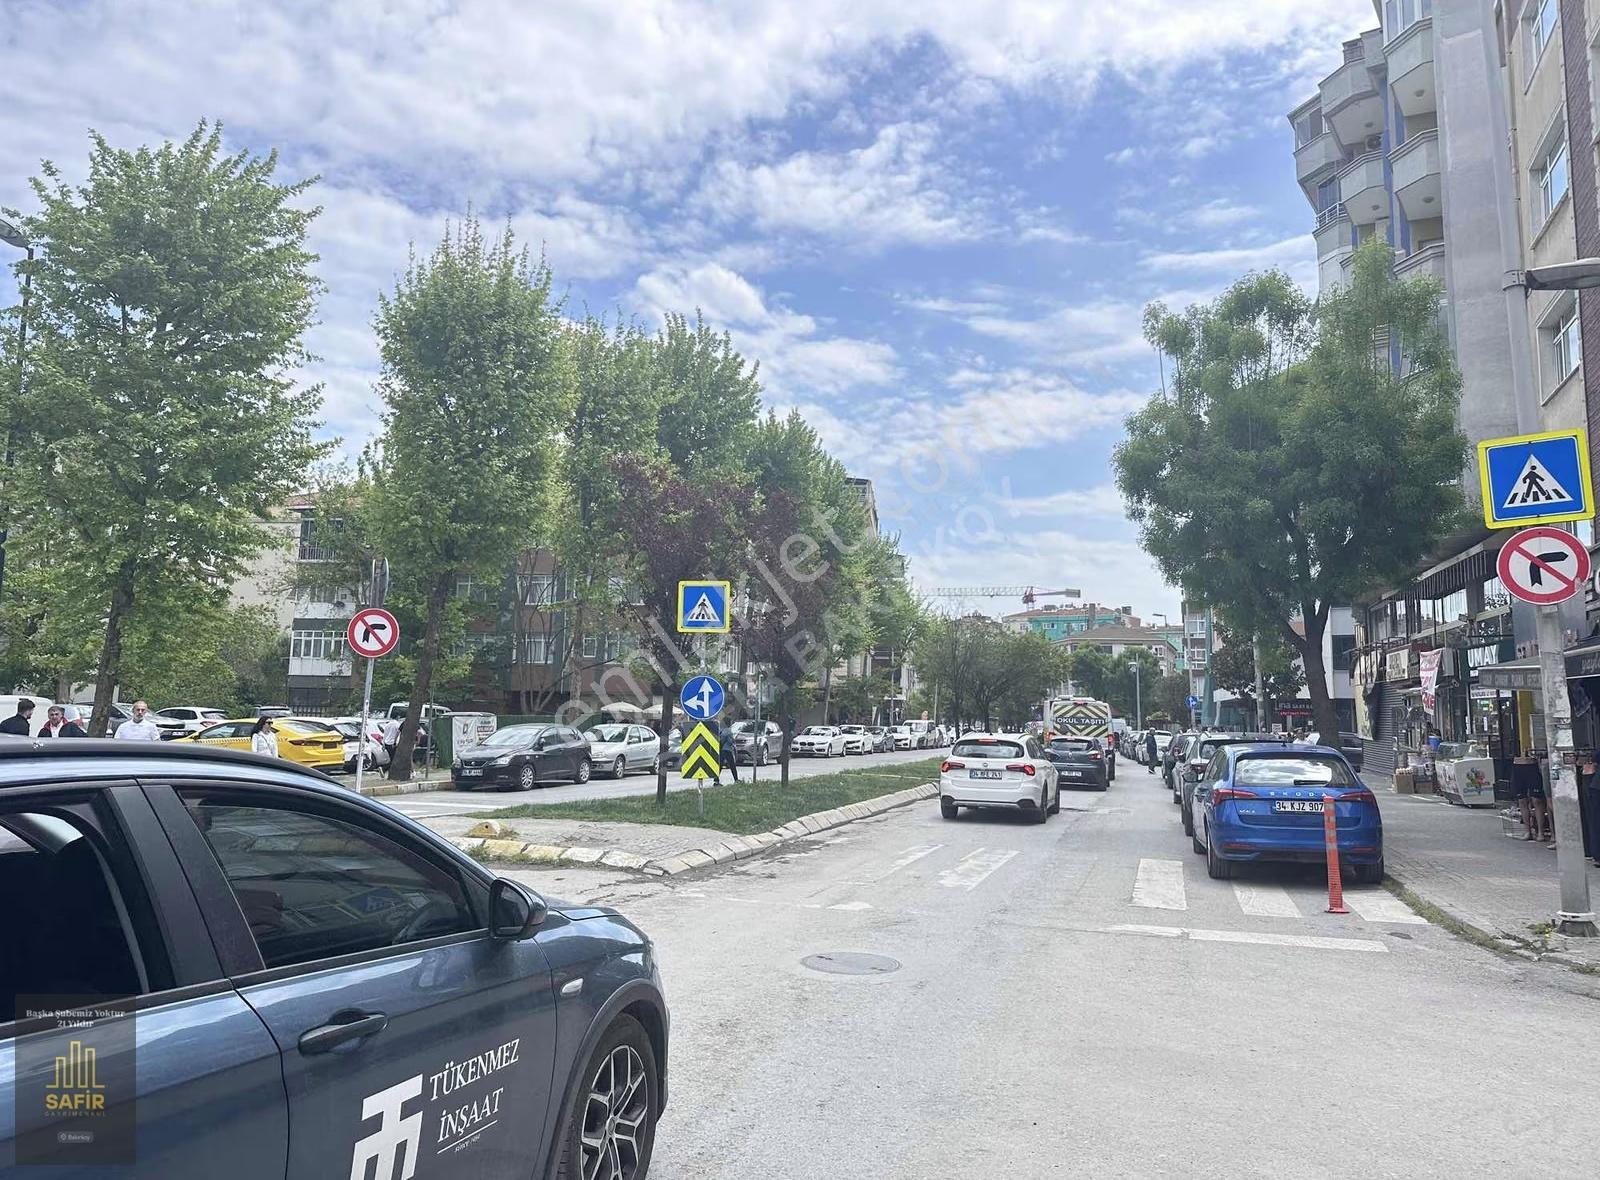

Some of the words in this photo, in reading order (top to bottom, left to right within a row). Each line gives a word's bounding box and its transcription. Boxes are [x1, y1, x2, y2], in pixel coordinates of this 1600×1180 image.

[1467, 644, 1497, 668] UMAY
[1276, 801, 1287, 810] 34
[1290, 802, 1307, 811] KJZ
[1308, 802, 1324, 812] 907
[429, 1038, 520, 1101] TÜKENMEZ
[437, 1087, 504, 1143] İNŞAAT
